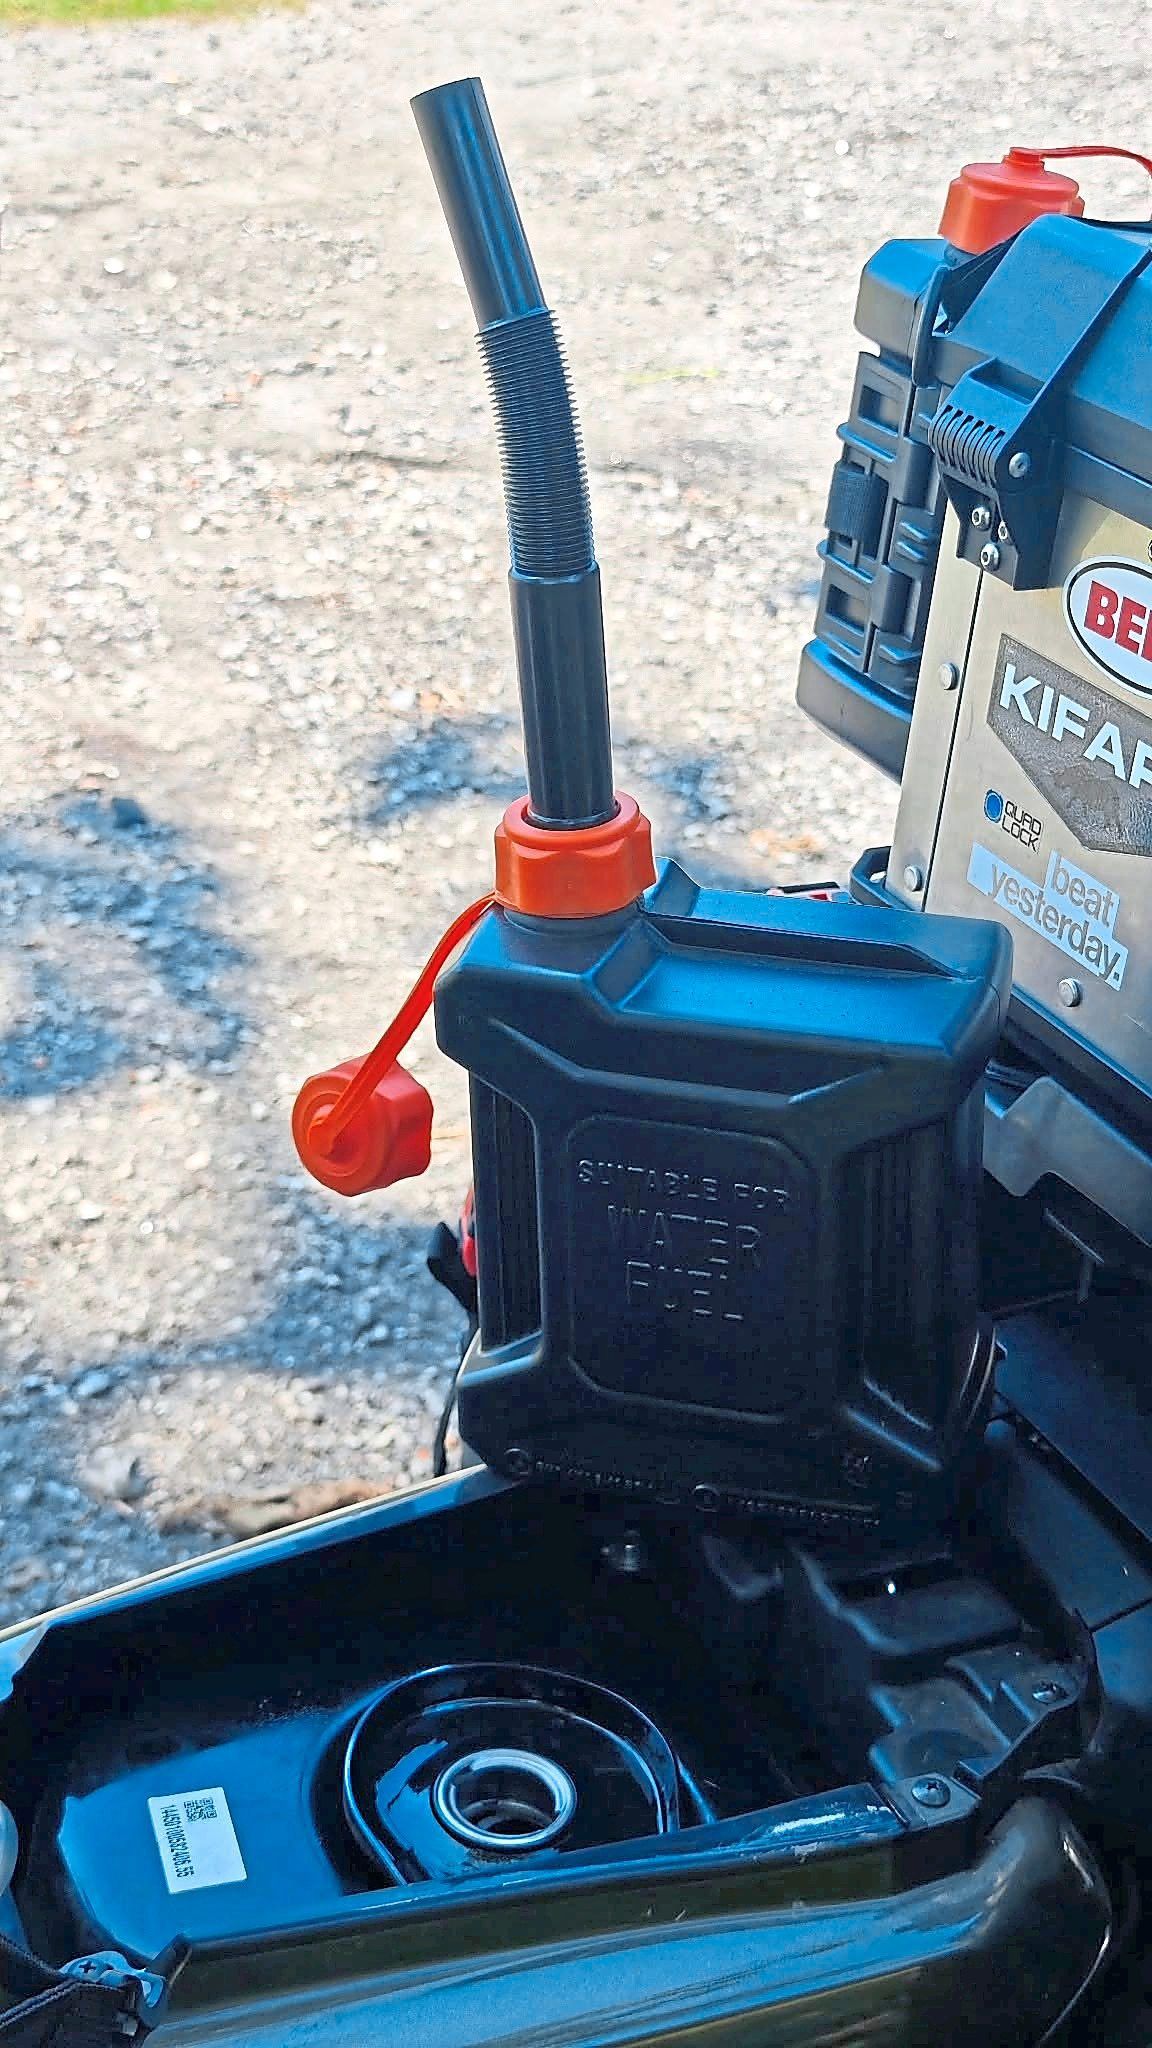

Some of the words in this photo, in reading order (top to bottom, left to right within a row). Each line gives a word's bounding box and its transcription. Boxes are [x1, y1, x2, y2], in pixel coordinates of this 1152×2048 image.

[1002, 816, 1038, 853] LOCK
[1005, 801, 1042, 836] QUAD
[990, 864, 1121, 981] yesterday.
[1051, 856, 1114, 927] beat
[607, 1203, 762, 1270] WATER
[627, 1259, 744, 1320] FUEL
